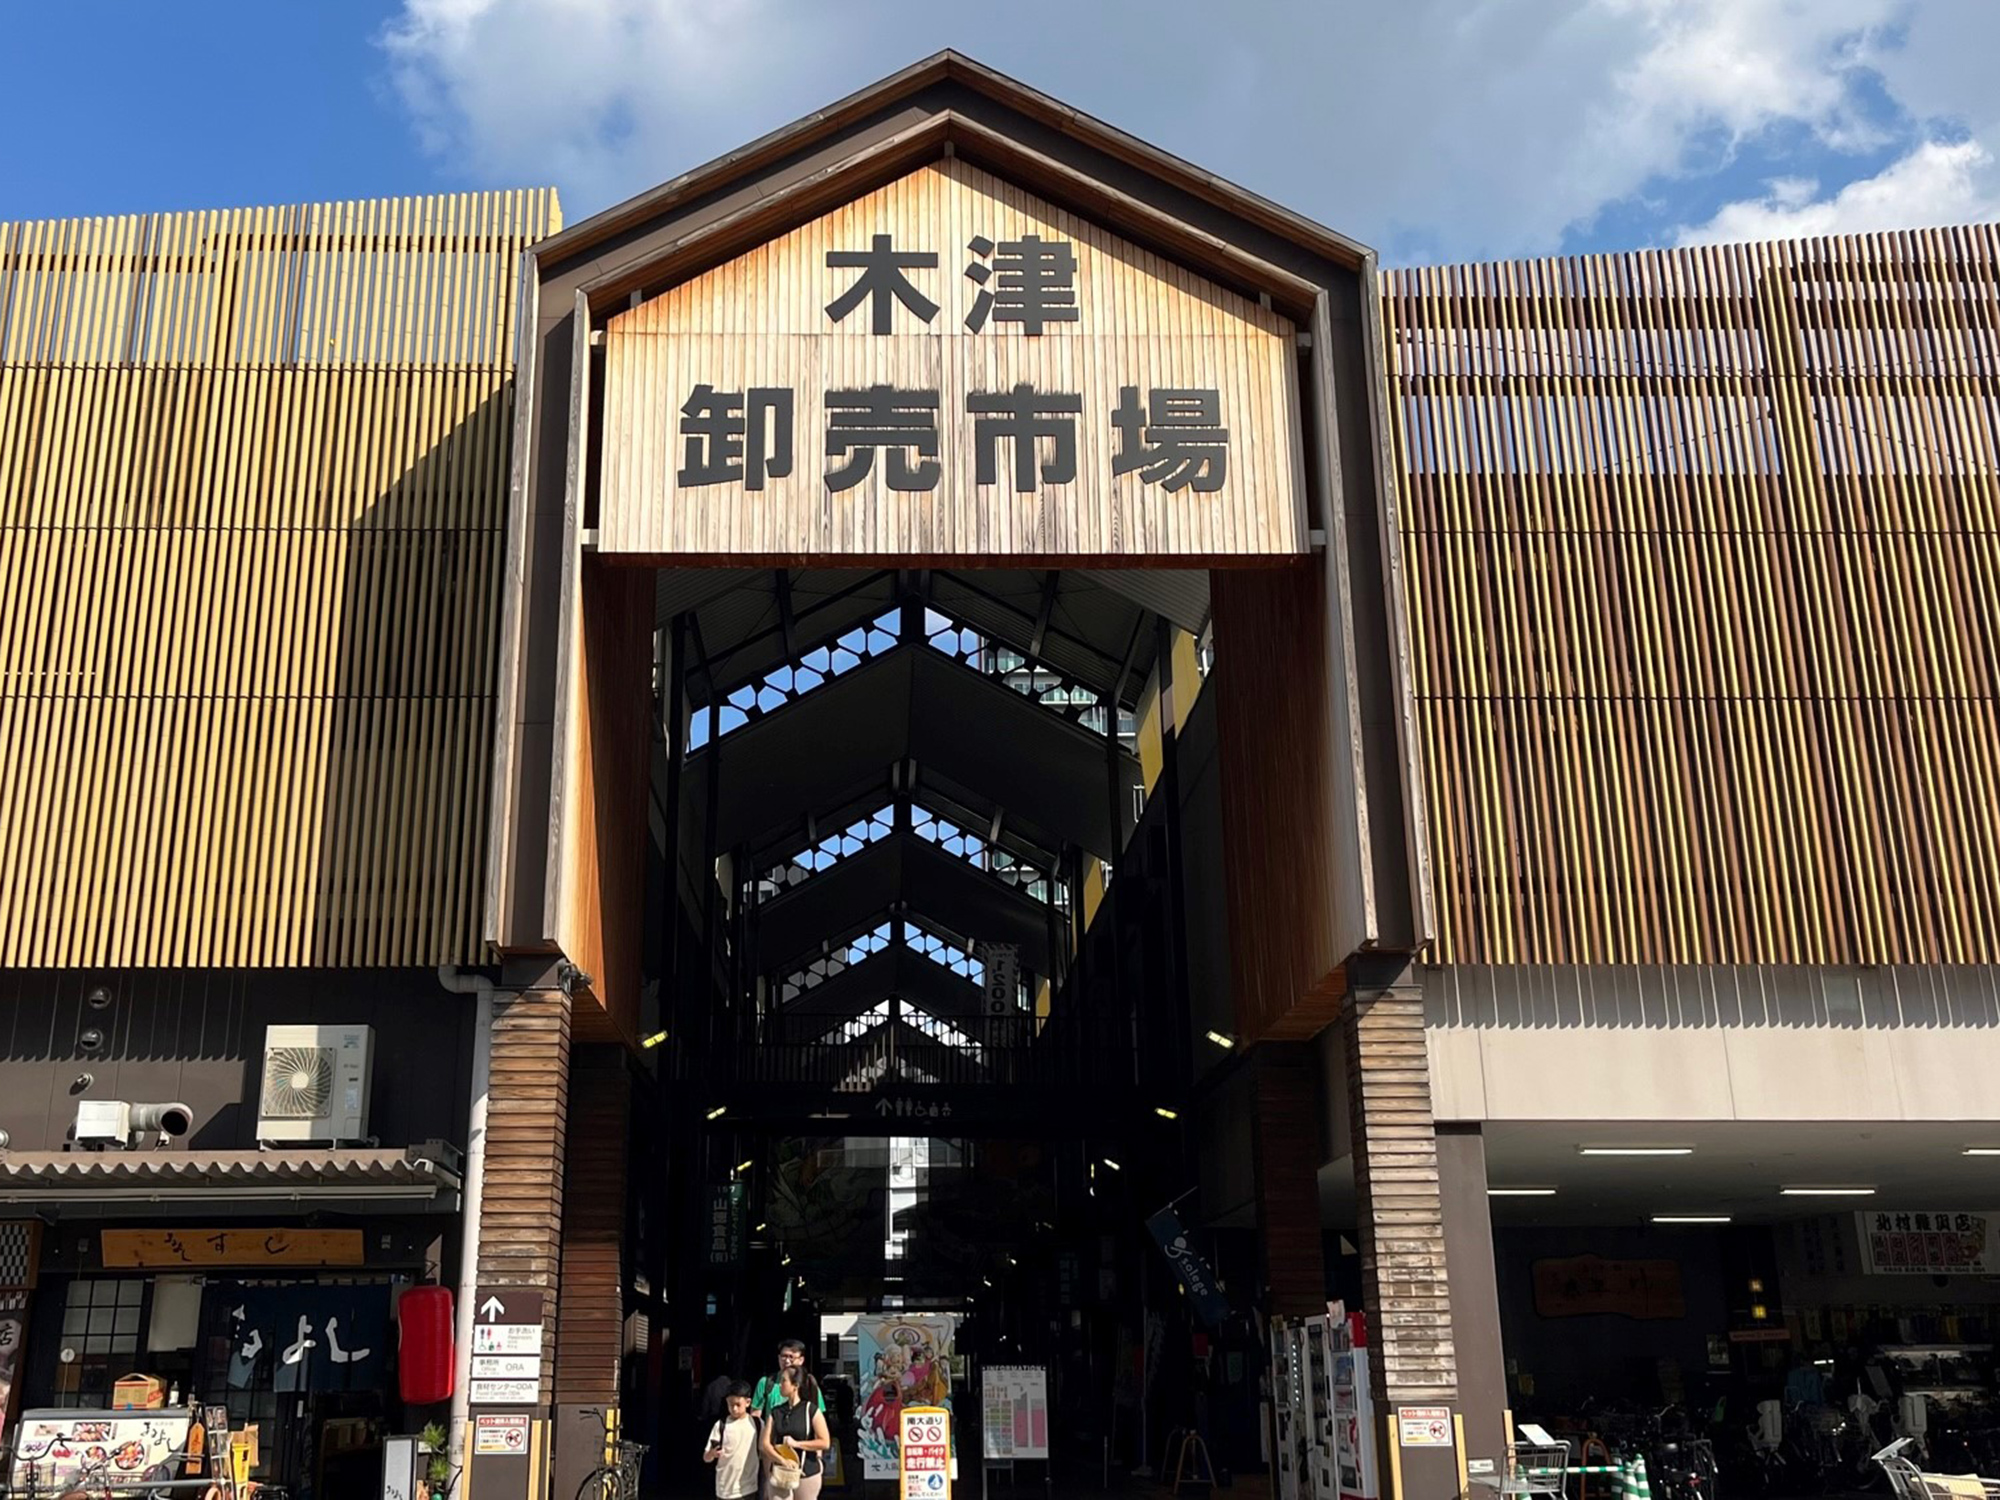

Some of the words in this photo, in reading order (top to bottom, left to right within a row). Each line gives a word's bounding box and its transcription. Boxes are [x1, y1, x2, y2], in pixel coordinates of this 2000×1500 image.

[825, 234, 1079, 336] 木津
[678, 383, 1229, 493] 卸売市場
[207, 1233, 290, 1256] すし
[907, 1417, 942, 1425] 南大通り
